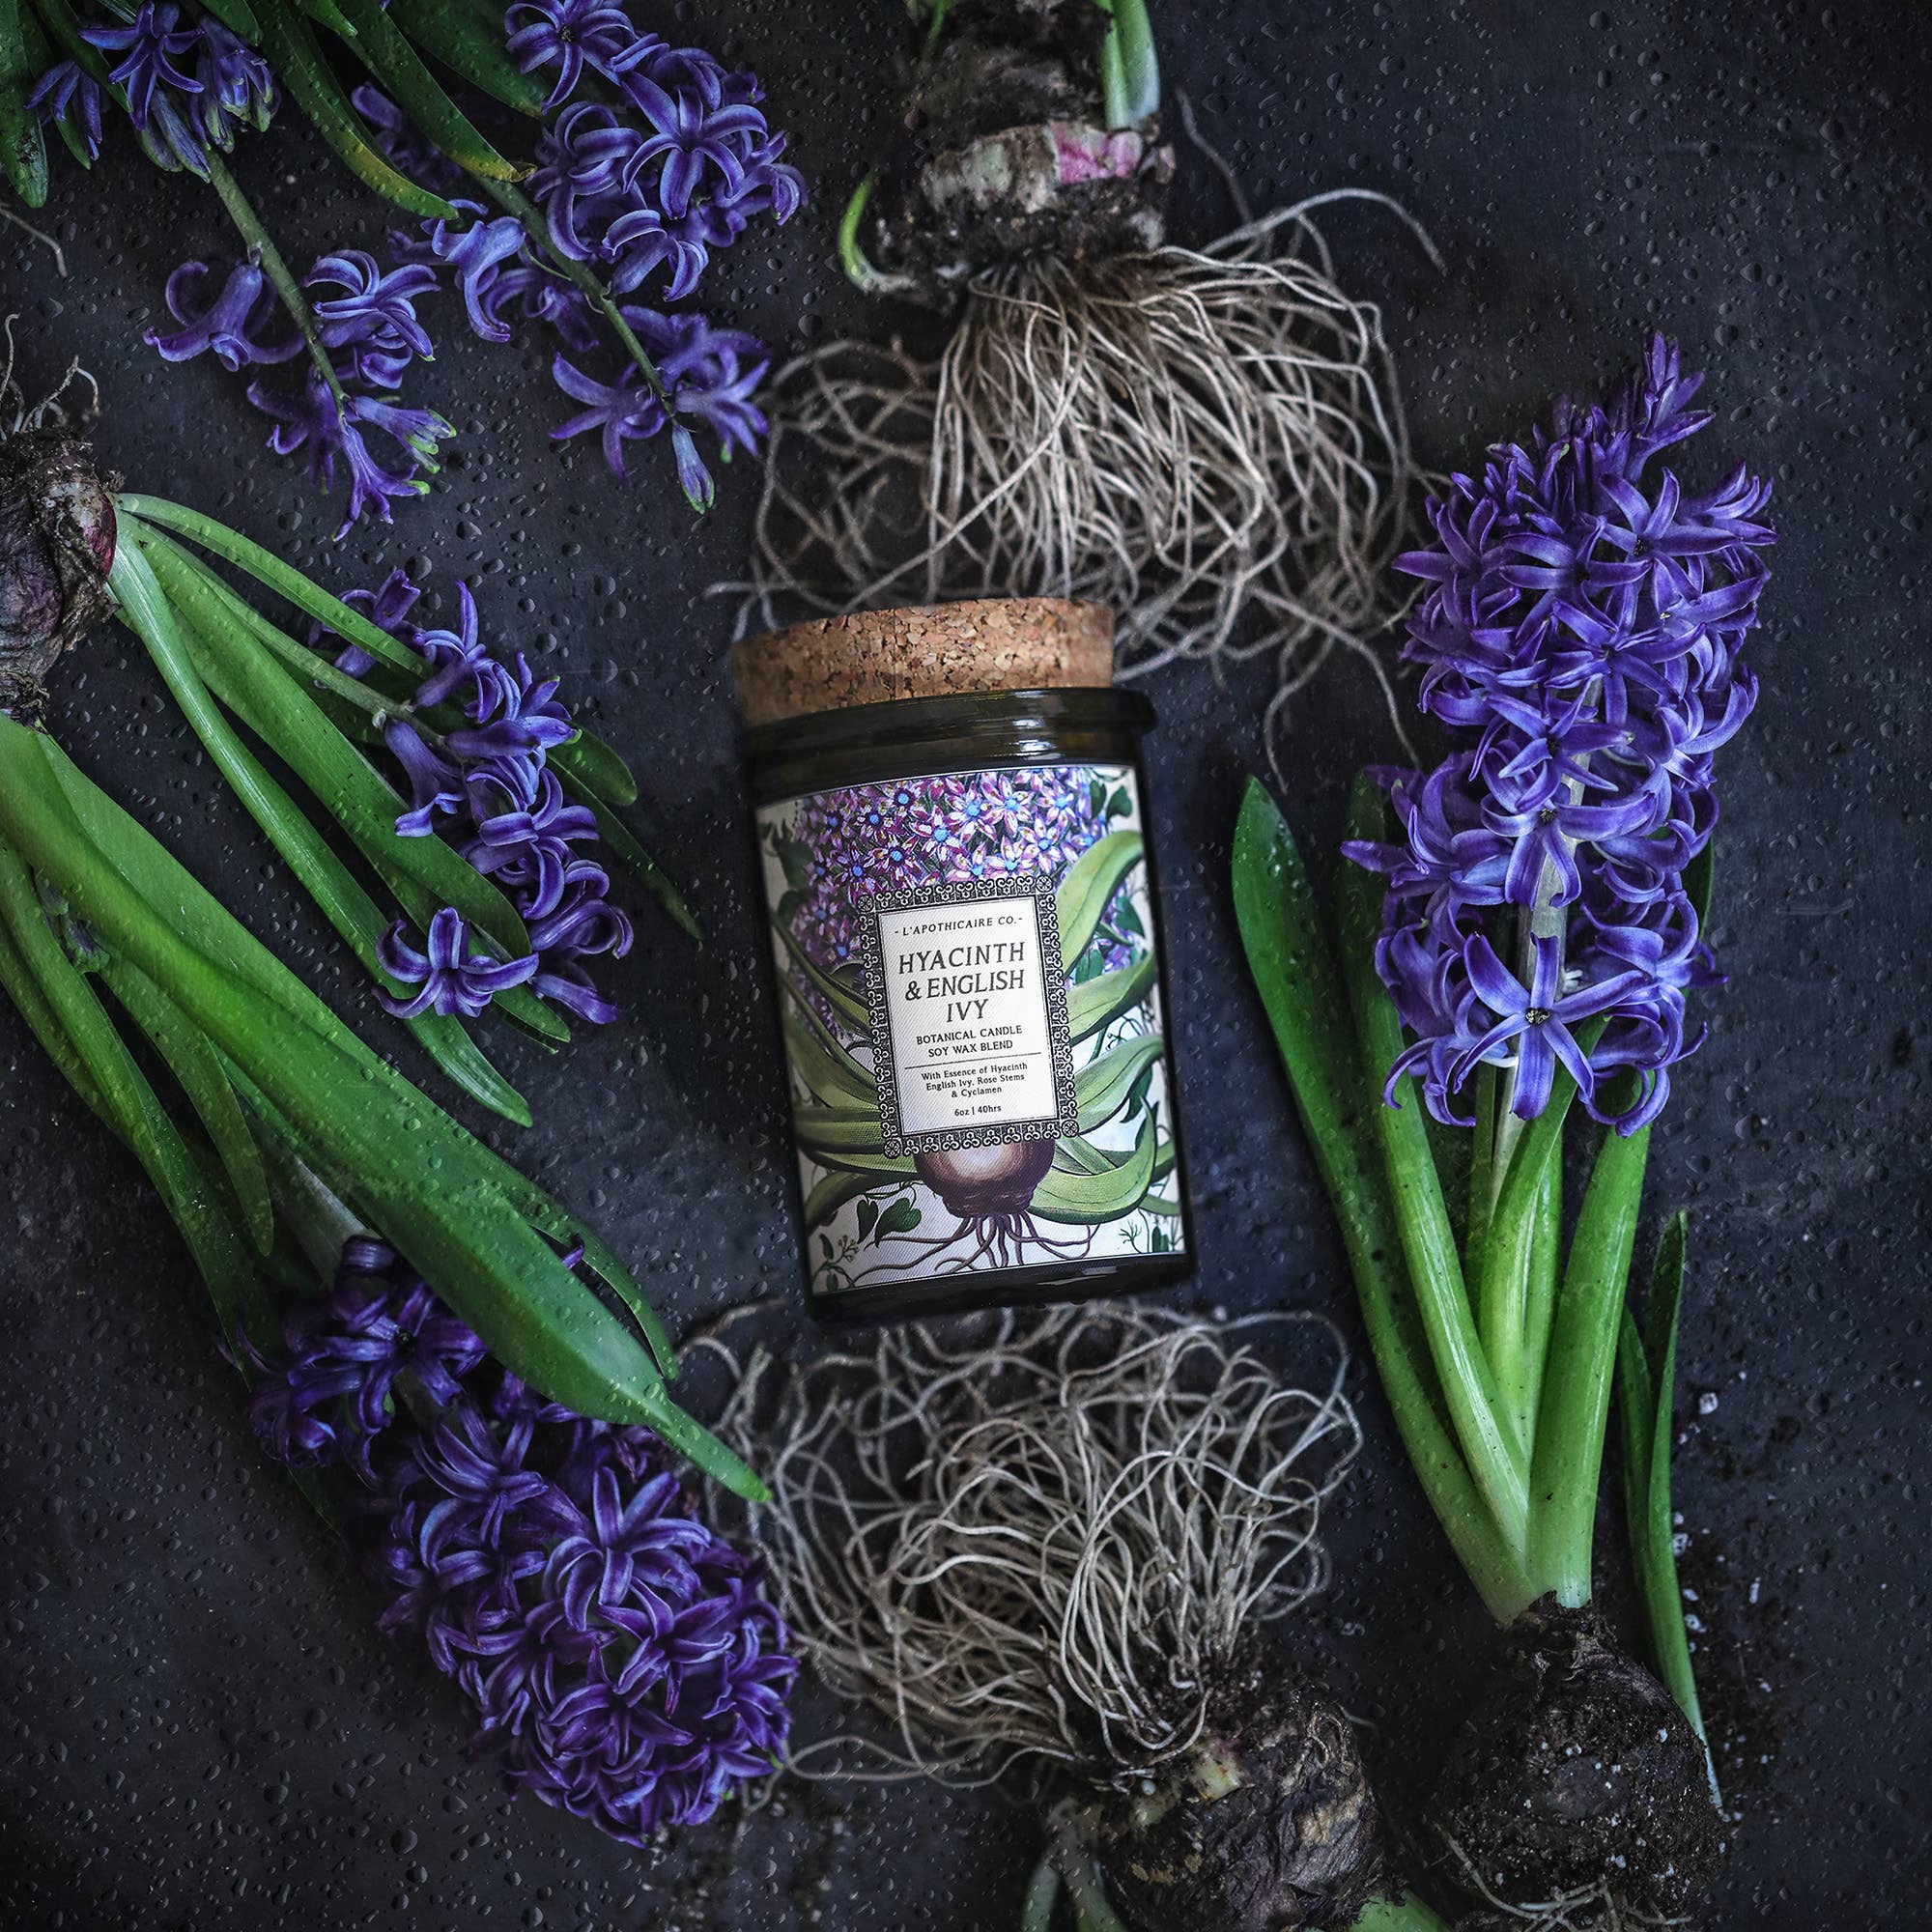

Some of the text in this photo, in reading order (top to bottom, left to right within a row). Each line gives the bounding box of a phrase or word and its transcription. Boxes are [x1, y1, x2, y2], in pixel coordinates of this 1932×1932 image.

[902, 918, 993, 936] L'APOTHICAIRE
[899, 942, 1025, 974] HYACINTH
[905, 970, 1024, 1001] & ENGLISH
[947, 999, 988, 1022] IVY
[917, 1026, 1022, 1045] BOTANICAL CANDLE
[928, 1040, 1013, 1058] SOY WAX BLEND
[921, 1070, 941, 1080] With
[944, 1069, 976, 1078] Essence
[991, 1063, 1027, 1074] Hyacinth
[926, 1080, 955, 1092] English
[961, 1087, 1002, 1097] Cyclamen
[978, 1105, 1001, 1114] 40hrs
